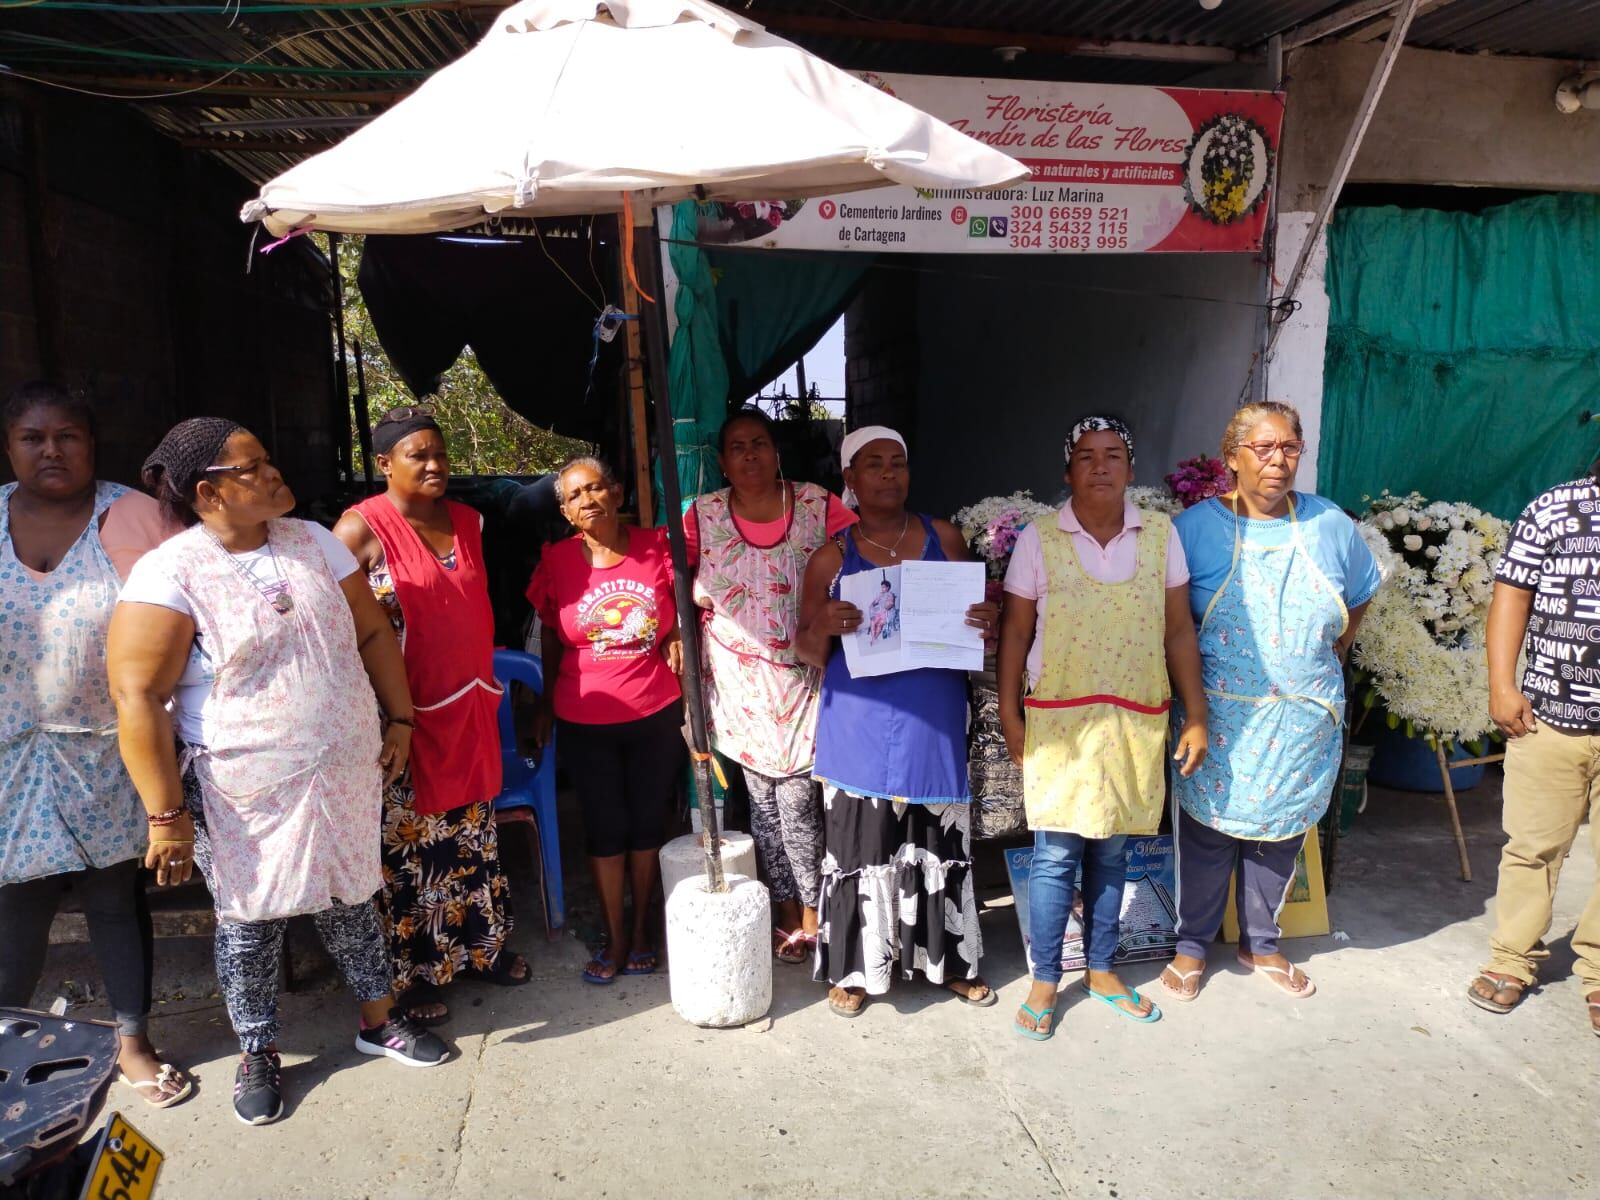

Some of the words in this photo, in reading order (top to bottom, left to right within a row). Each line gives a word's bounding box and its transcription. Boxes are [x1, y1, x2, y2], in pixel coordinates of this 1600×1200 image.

[986, 94, 1113, 126] Floristería
[1031, 123, 1058, 148] de
[1065, 124, 1104, 149] las
[1113, 126, 1187, 153] Flores
[1044, 163, 1100, 178] naturales
[1101, 167, 1110, 180] y
[1112, 165, 1175, 181] artificiales
[1032, 186, 1054, 202] Luz
[1058, 187, 1104, 203] Marina
[840, 203, 898, 220] Cementerio
[901, 202, 942, 221] Jardines
[1010, 205, 1043, 220] 300
[1050, 206, 1093, 220] 6659
[1098, 207, 1129, 220] 521
[838, 226, 851, 241] de
[854, 226, 906, 244] Cartagena
[1009, 220, 1043, 234] 324
[1049, 220, 1092, 234] 5432
[1099, 221, 1128, 235] 115
[1009, 235, 1043, 249] 304
[1047, 235, 1091, 249] 3083
[1097, 235, 1128, 249] 995
[1542, 557, 1600, 576] OMMY
[577, 578, 655, 613] GRATITUDE
[1533, 636, 1589, 663] TOMMY
[1523, 671, 1560, 696] JEANS
